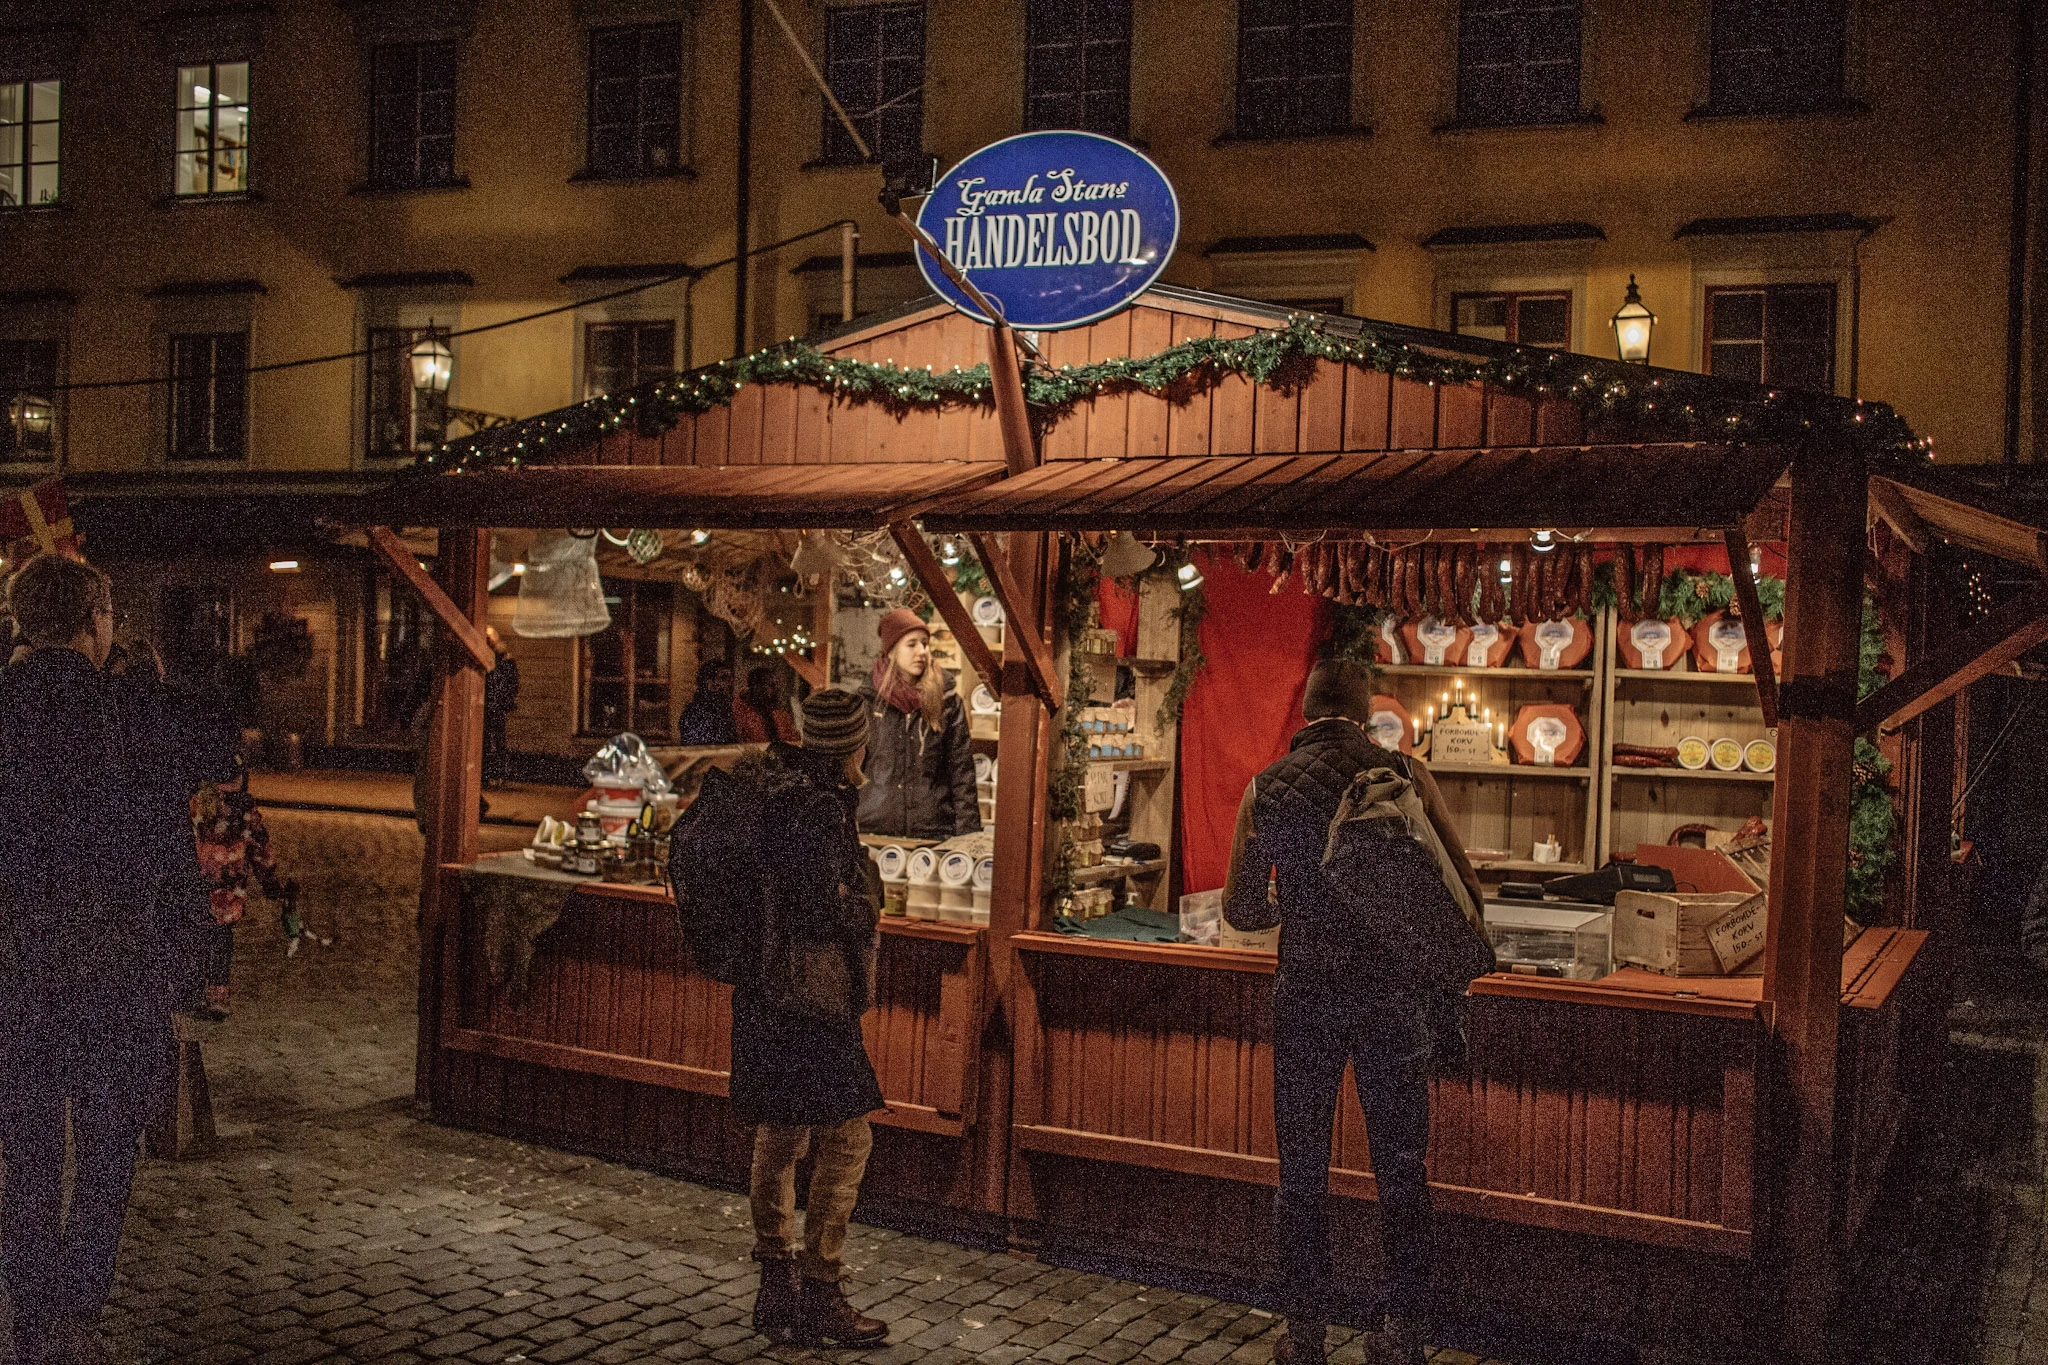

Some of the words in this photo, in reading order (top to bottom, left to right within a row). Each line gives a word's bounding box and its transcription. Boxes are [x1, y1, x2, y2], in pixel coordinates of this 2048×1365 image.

[956, 174, 1046, 215] Gamla
[1047, 168, 1130, 203] Stans
[1450, 737, 1473, 745] KORV
[1731, 921, 1754, 941] KORV
